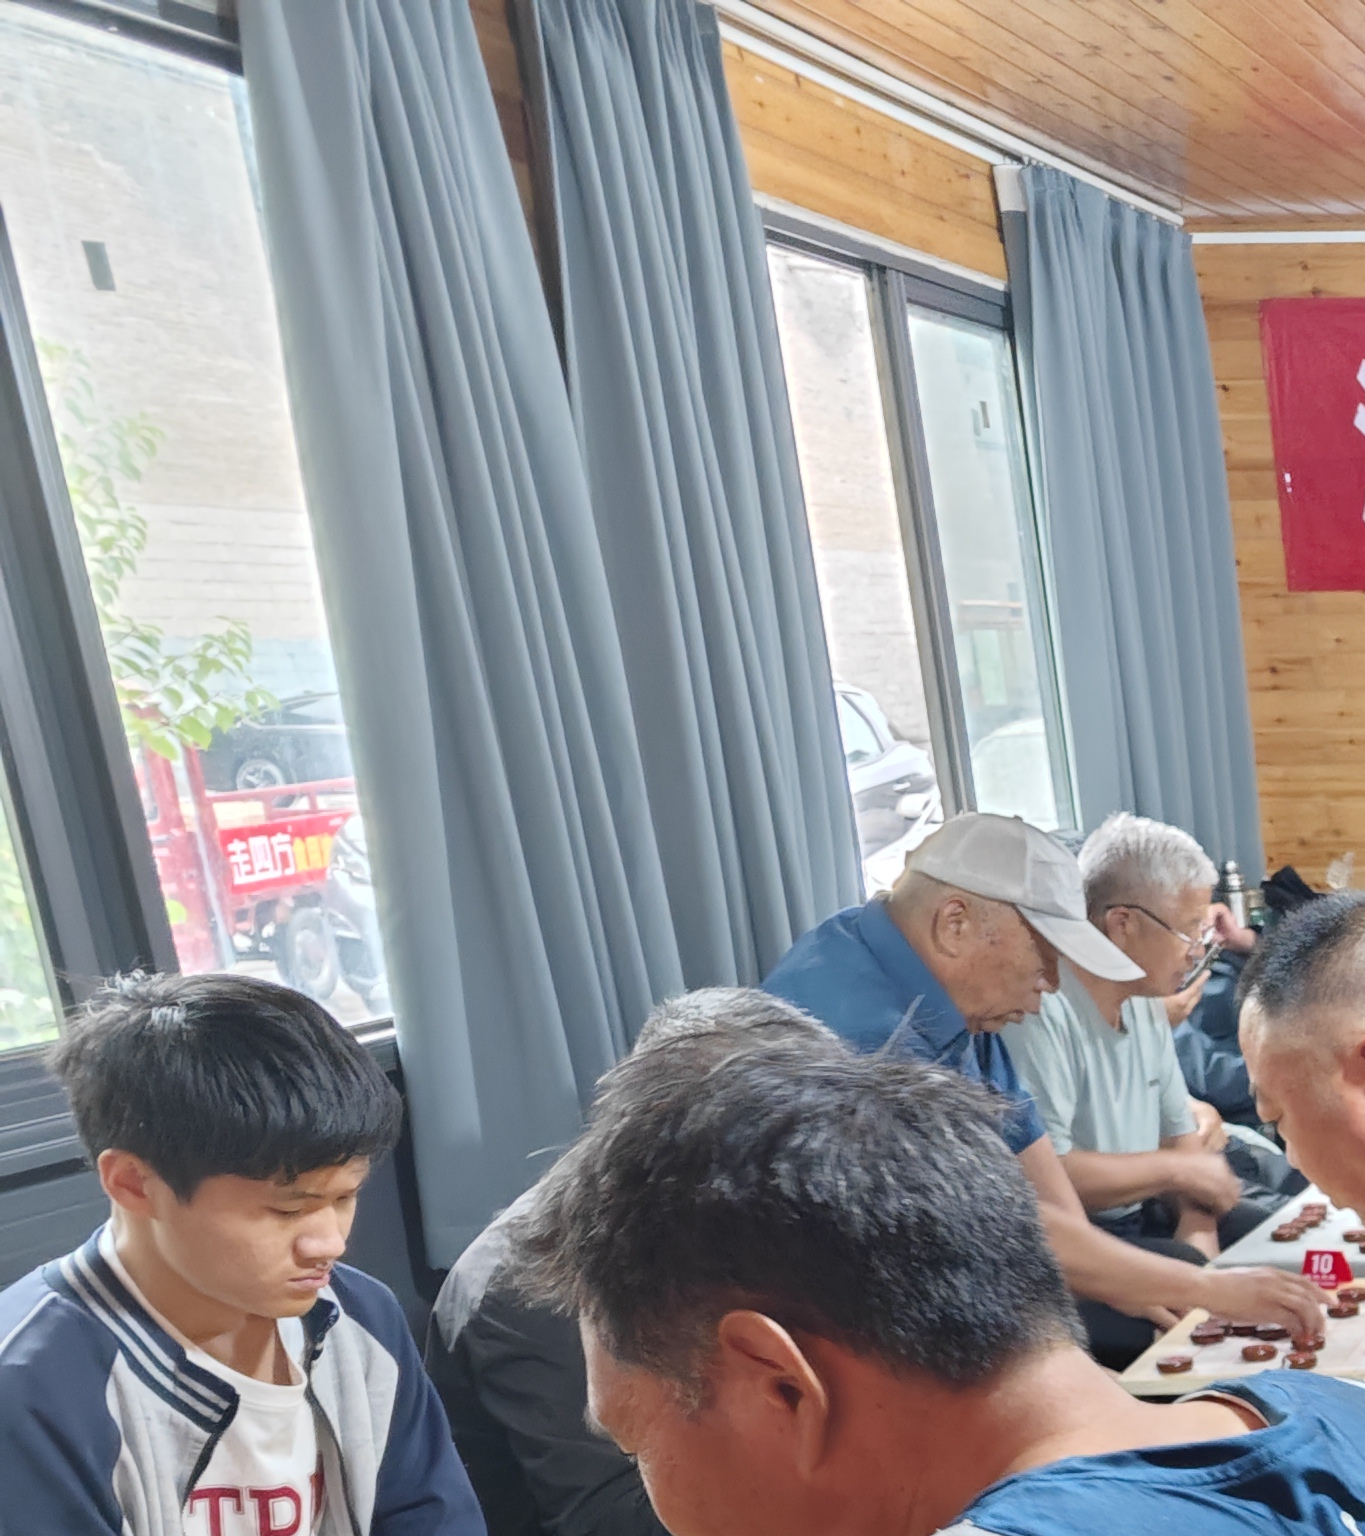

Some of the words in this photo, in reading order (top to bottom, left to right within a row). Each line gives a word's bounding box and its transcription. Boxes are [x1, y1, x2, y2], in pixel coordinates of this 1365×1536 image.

[227, 832, 296, 884] 走四方
[1311, 1253, 1334, 1274] 10
